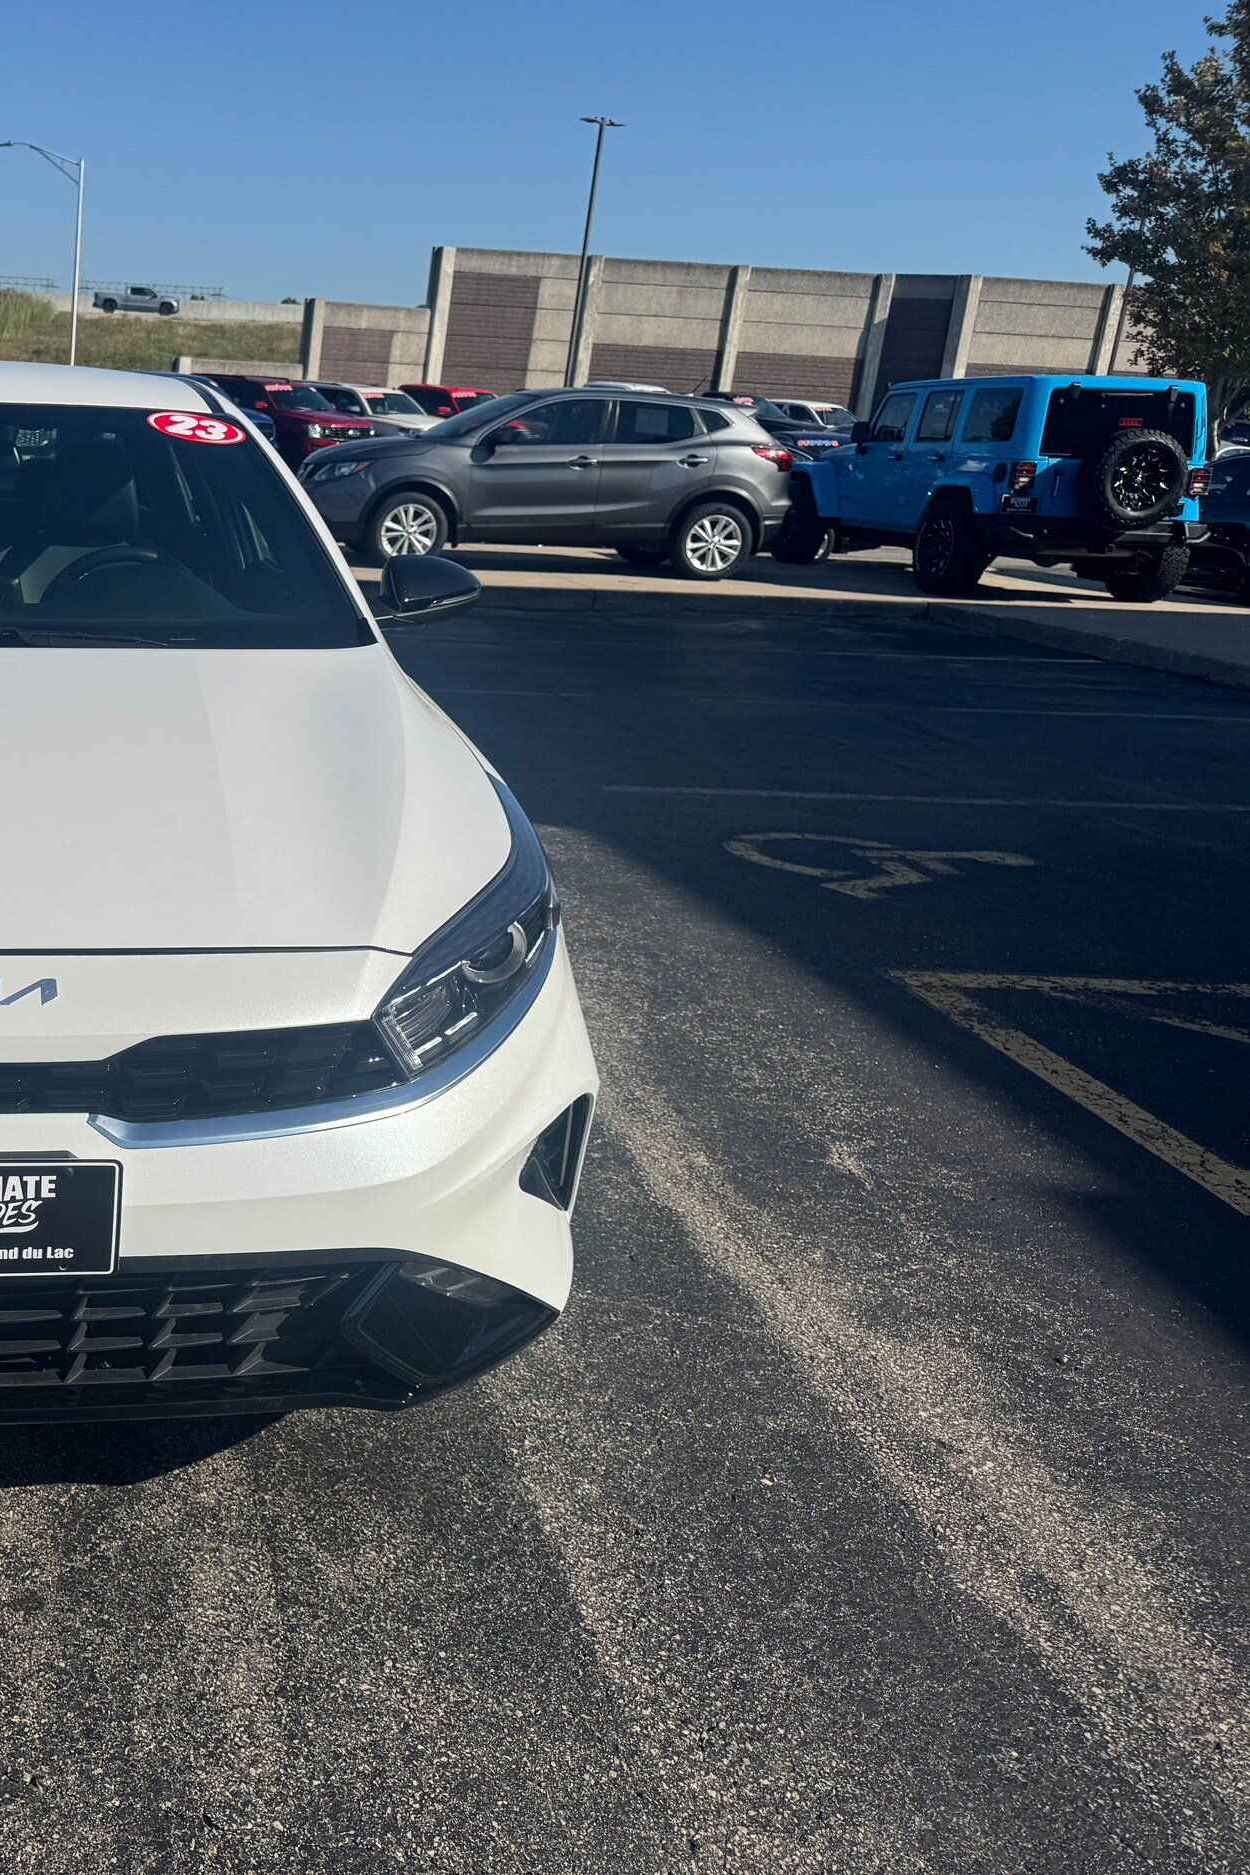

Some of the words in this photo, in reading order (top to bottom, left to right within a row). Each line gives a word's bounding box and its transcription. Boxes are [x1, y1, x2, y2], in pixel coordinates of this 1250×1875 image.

[165, 415, 228, 440] 23
[22, 1247, 42, 1259] du
[45, 1247, 74, 1259] Lac
